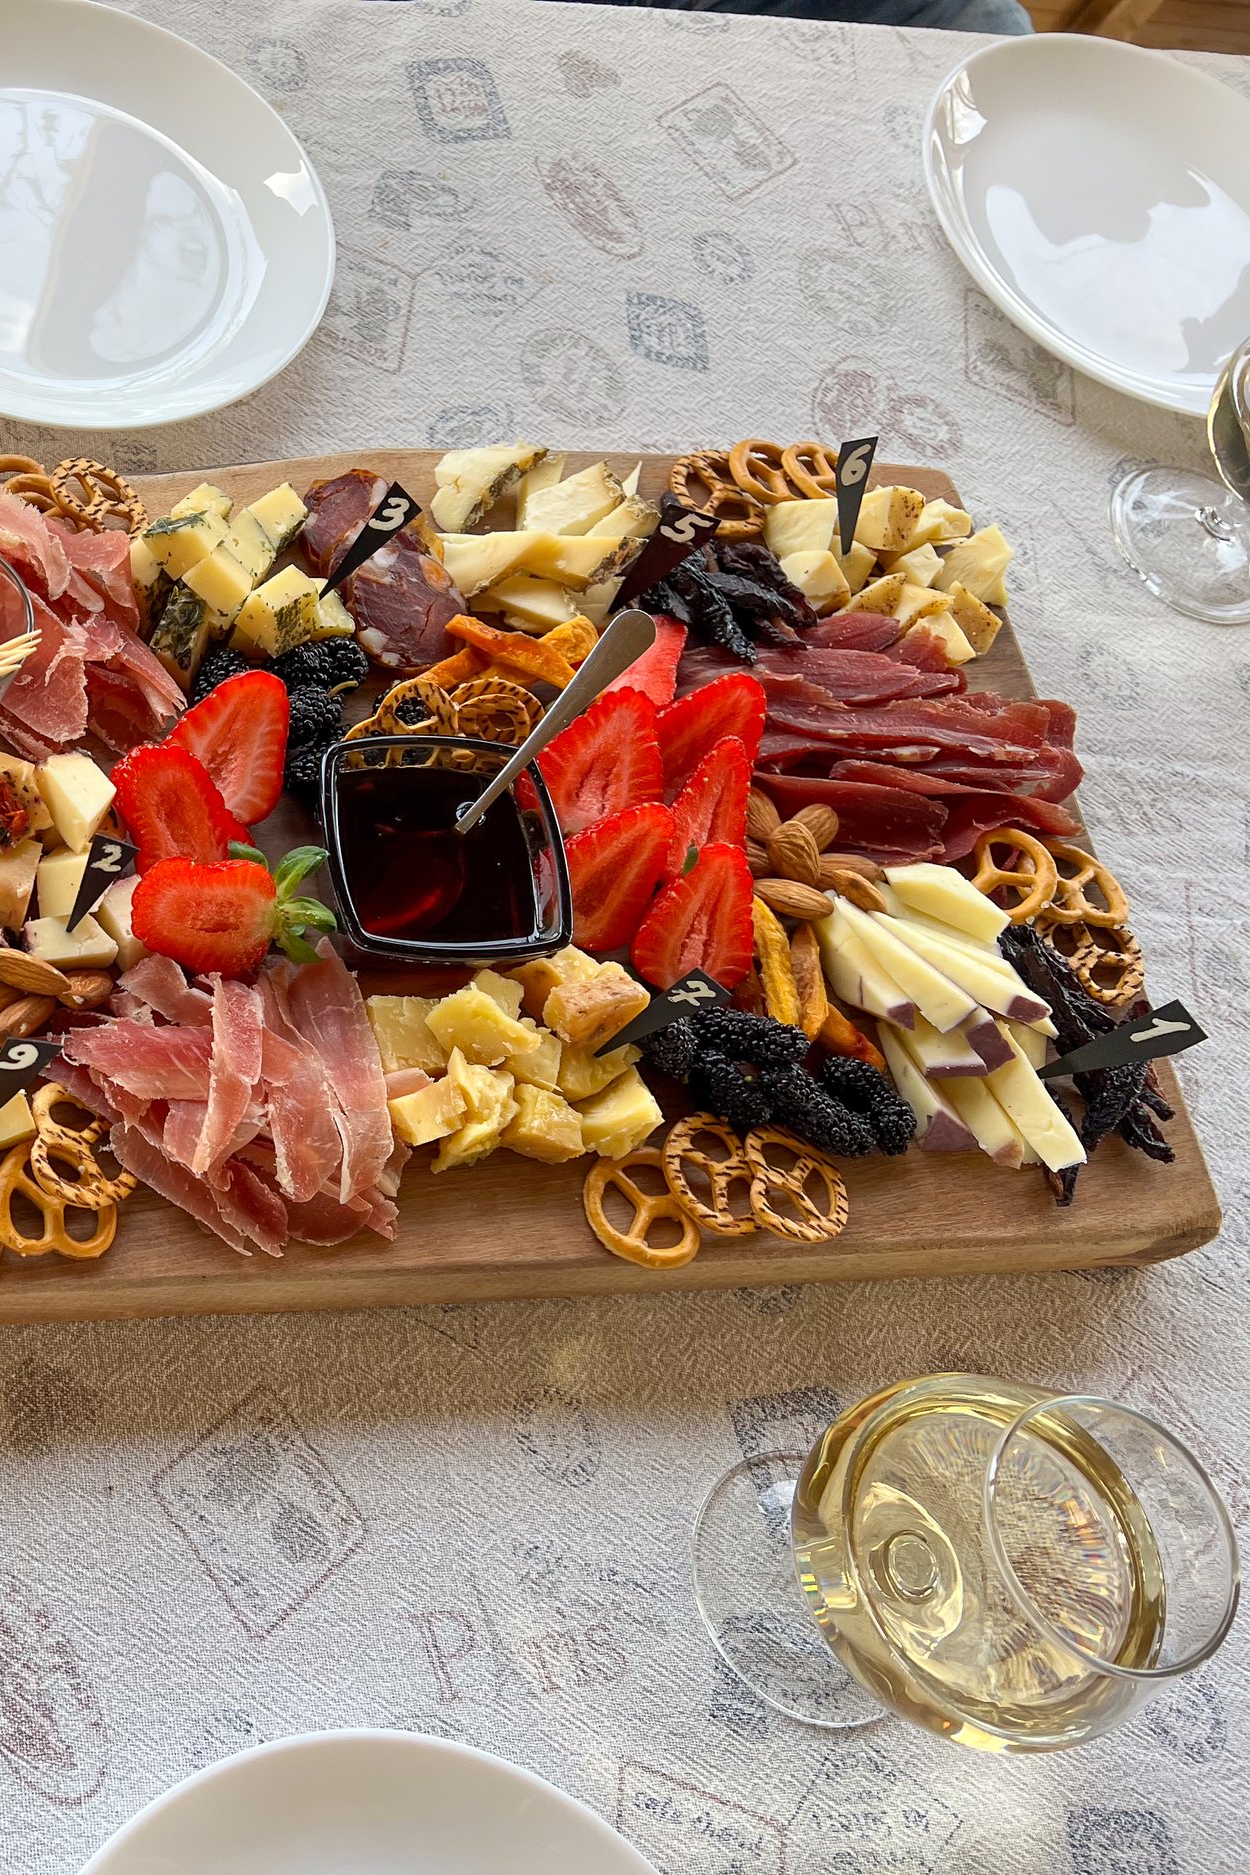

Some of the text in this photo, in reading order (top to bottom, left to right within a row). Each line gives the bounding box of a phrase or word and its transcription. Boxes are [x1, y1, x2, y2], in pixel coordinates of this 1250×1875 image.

[841, 443, 871, 485] 6
[370, 497, 410, 531] 3
[659, 513, 711, 543] 5
[89, 844, 122, 872] 2
[667, 980, 717, 1007] 7
[1129, 1017, 1192, 1043] 1
